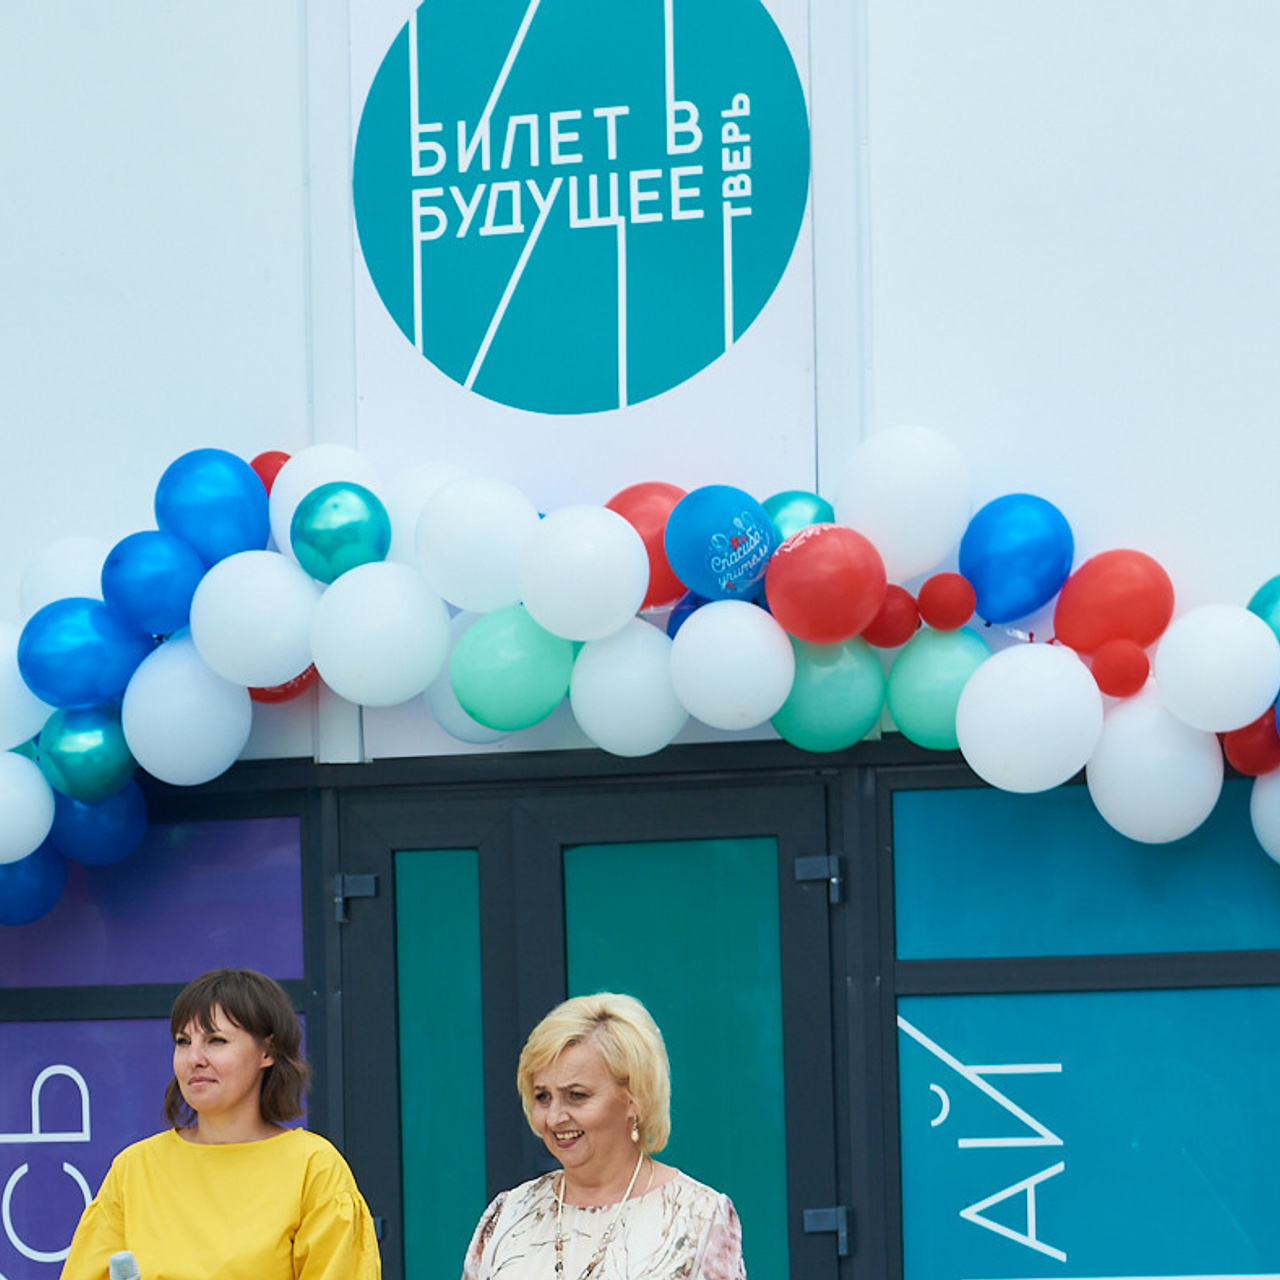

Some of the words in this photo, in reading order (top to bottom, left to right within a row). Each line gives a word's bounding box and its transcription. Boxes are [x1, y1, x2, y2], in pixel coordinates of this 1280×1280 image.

[411, 105, 630, 177] БИЛЕТ
[664, 100, 704, 155] В
[720, 92, 753, 218] ТВЕРЬ
[411, 165, 705, 242] БУДУЩЕЕ
